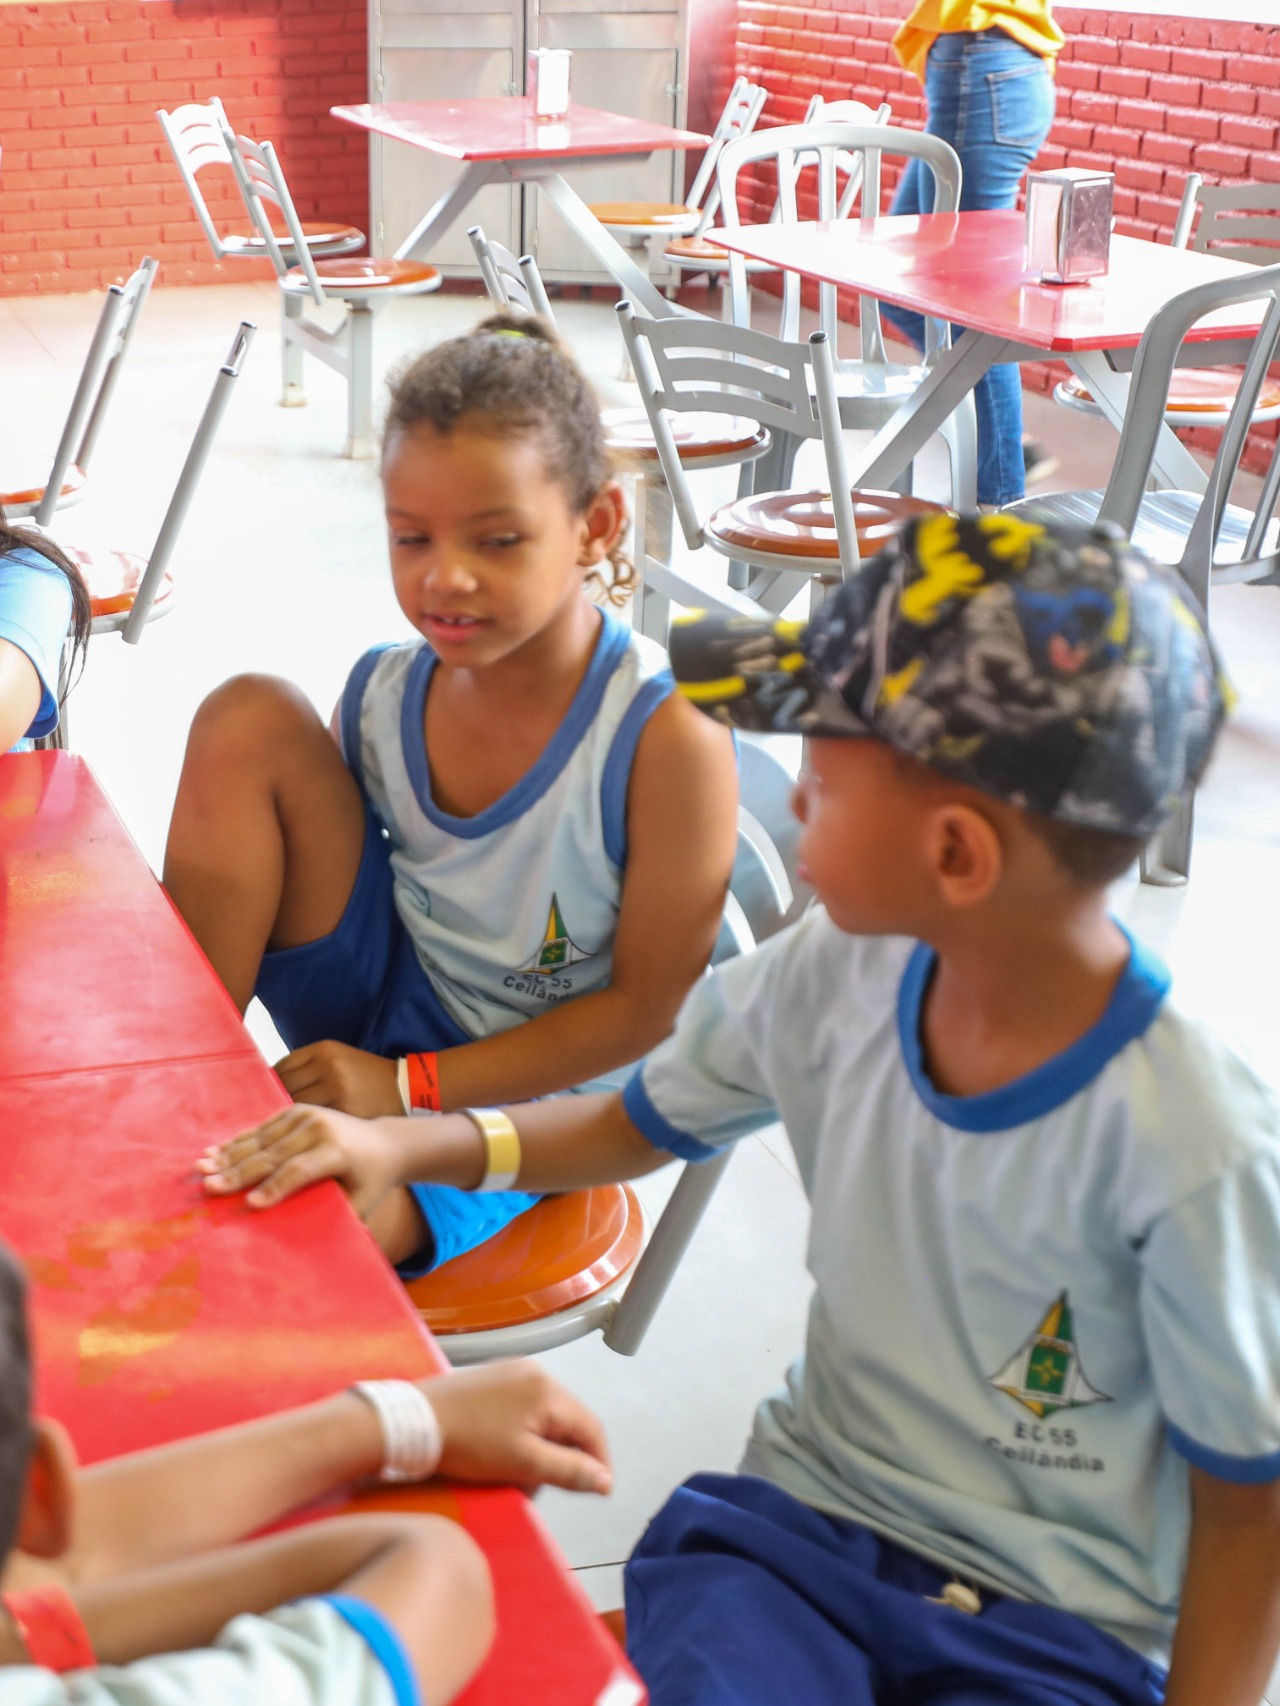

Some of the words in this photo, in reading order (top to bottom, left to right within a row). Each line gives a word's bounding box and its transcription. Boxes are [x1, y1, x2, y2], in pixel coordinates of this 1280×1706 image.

[552, 977, 573, 989] 55
[1015, 1421, 1043, 1442] EC
[1049, 1427, 1077, 1446] 55
